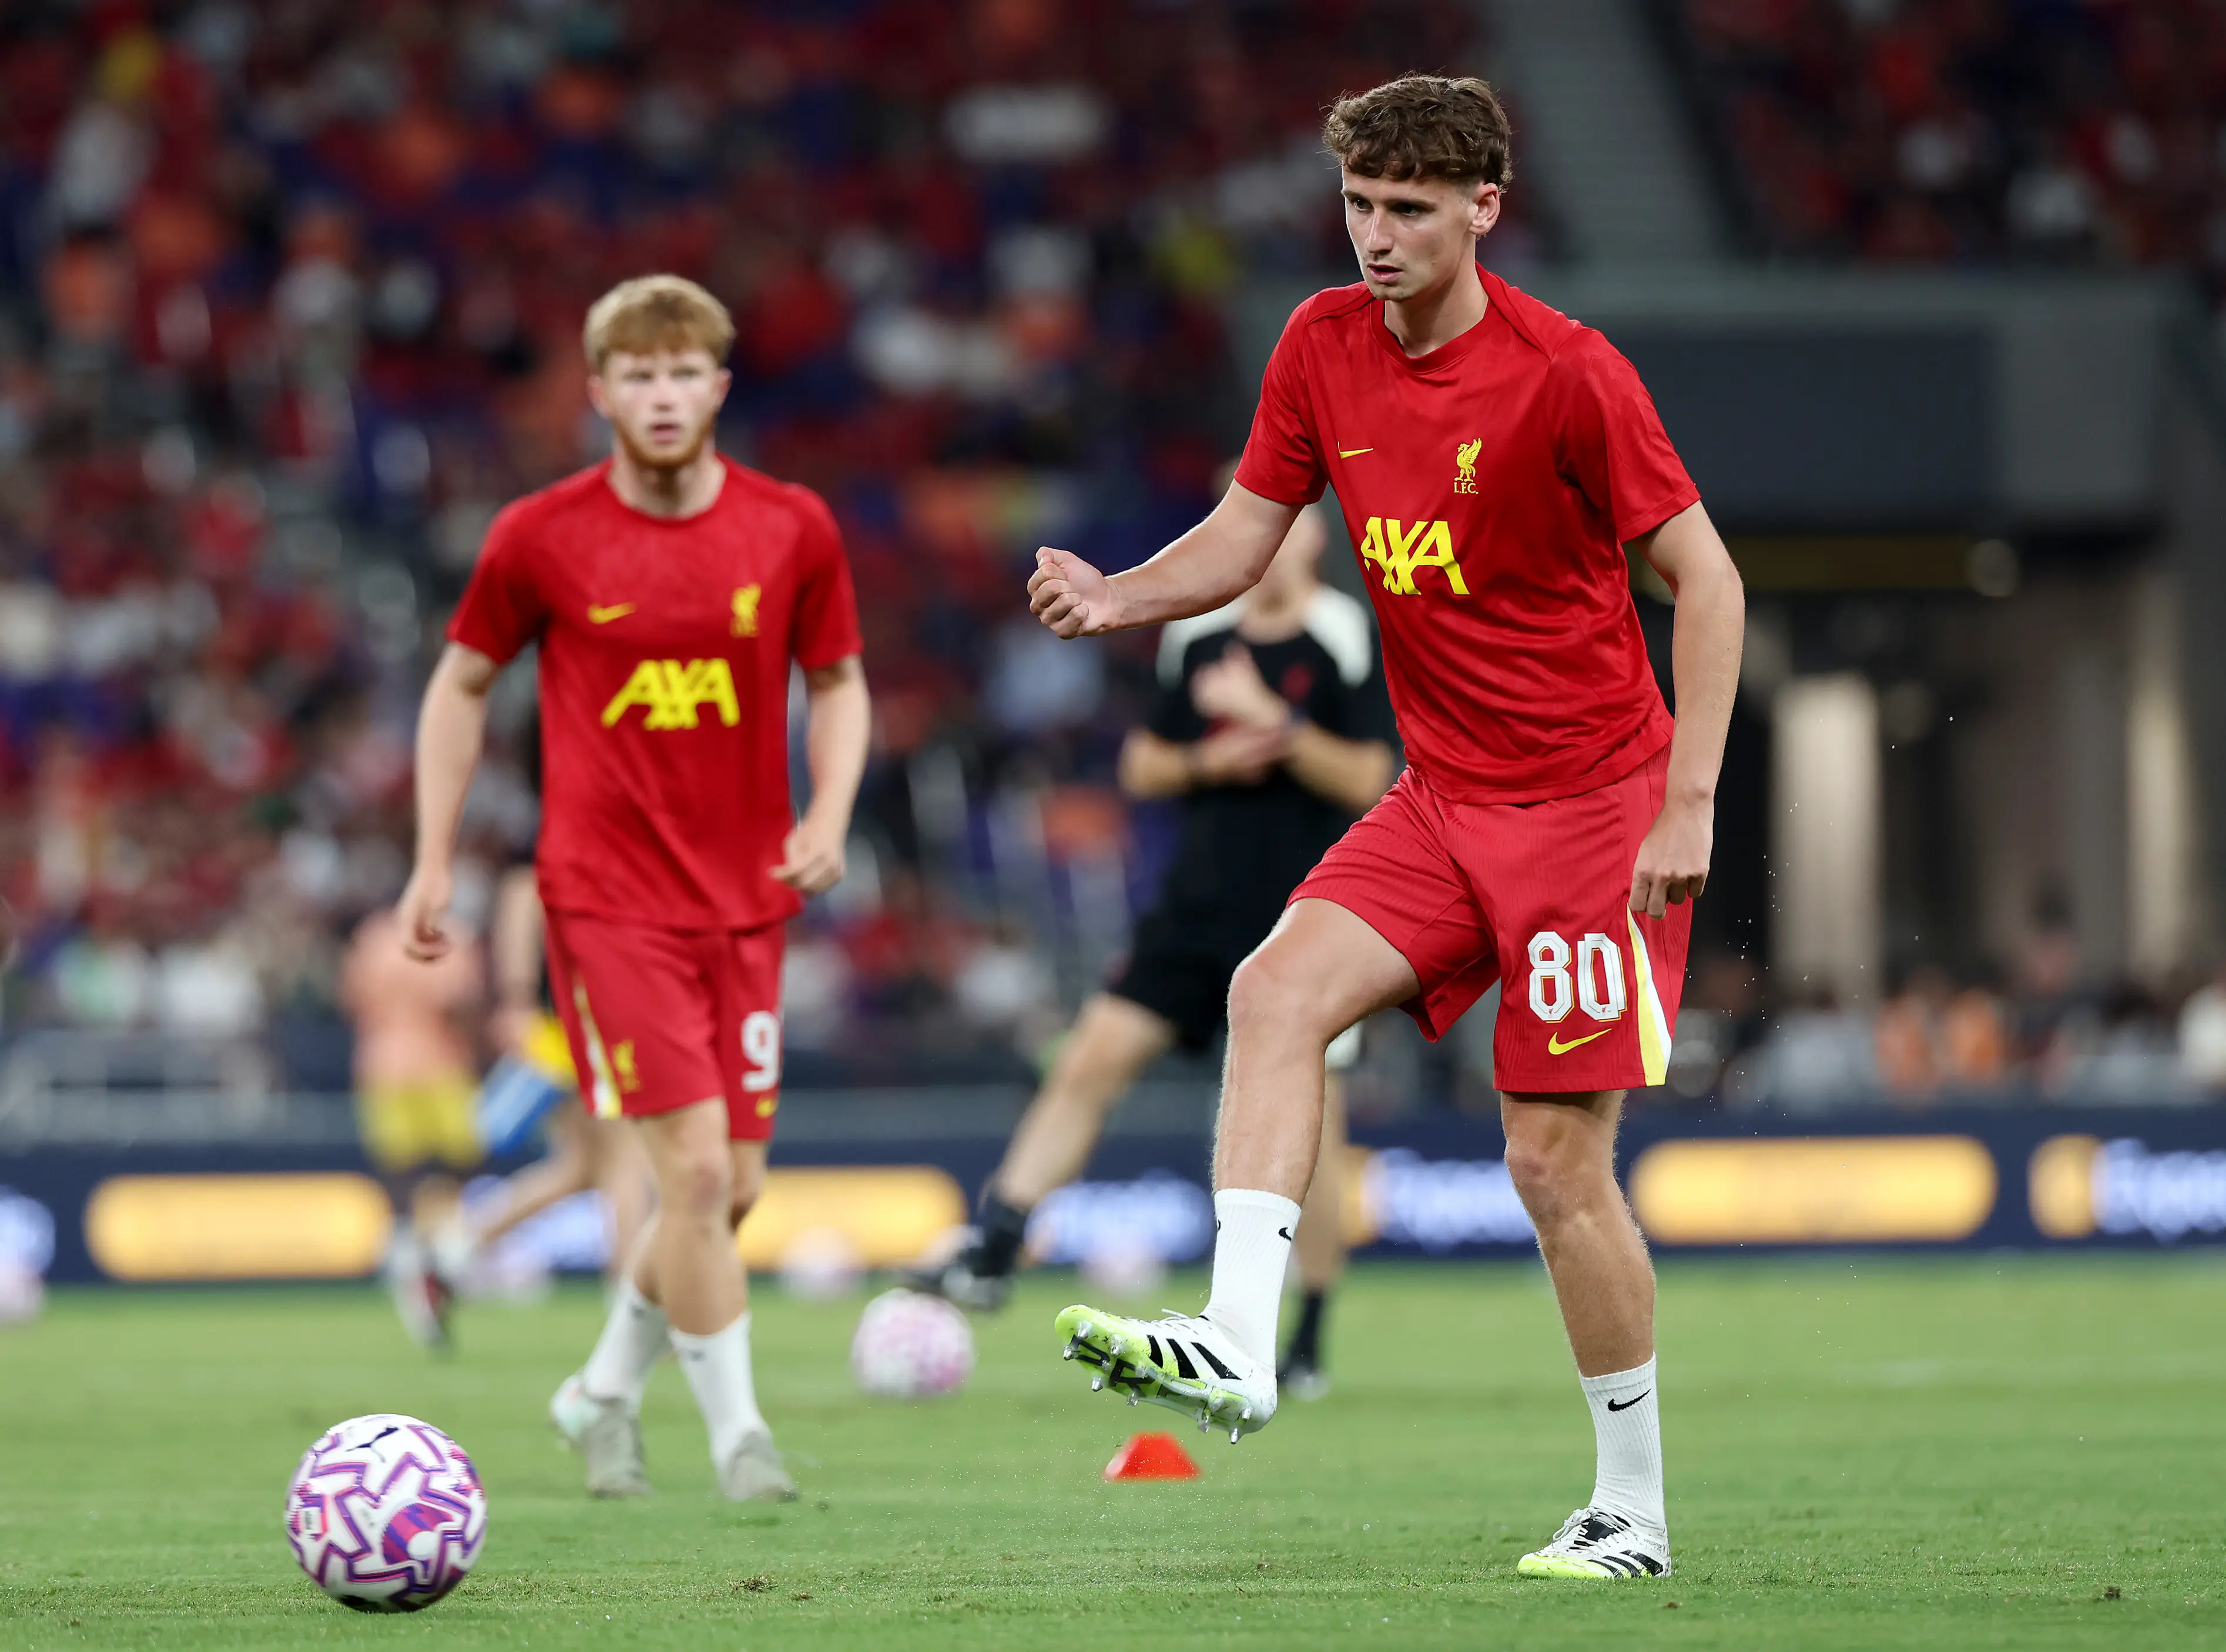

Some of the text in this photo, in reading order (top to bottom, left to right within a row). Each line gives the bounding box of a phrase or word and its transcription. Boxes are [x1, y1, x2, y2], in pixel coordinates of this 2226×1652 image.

[1454, 482, 1479, 494] L.F.C.
[1360, 516, 1470, 595] AXA
[601, 658, 740, 731] AXA
[1527, 931, 1627, 1023] 80
